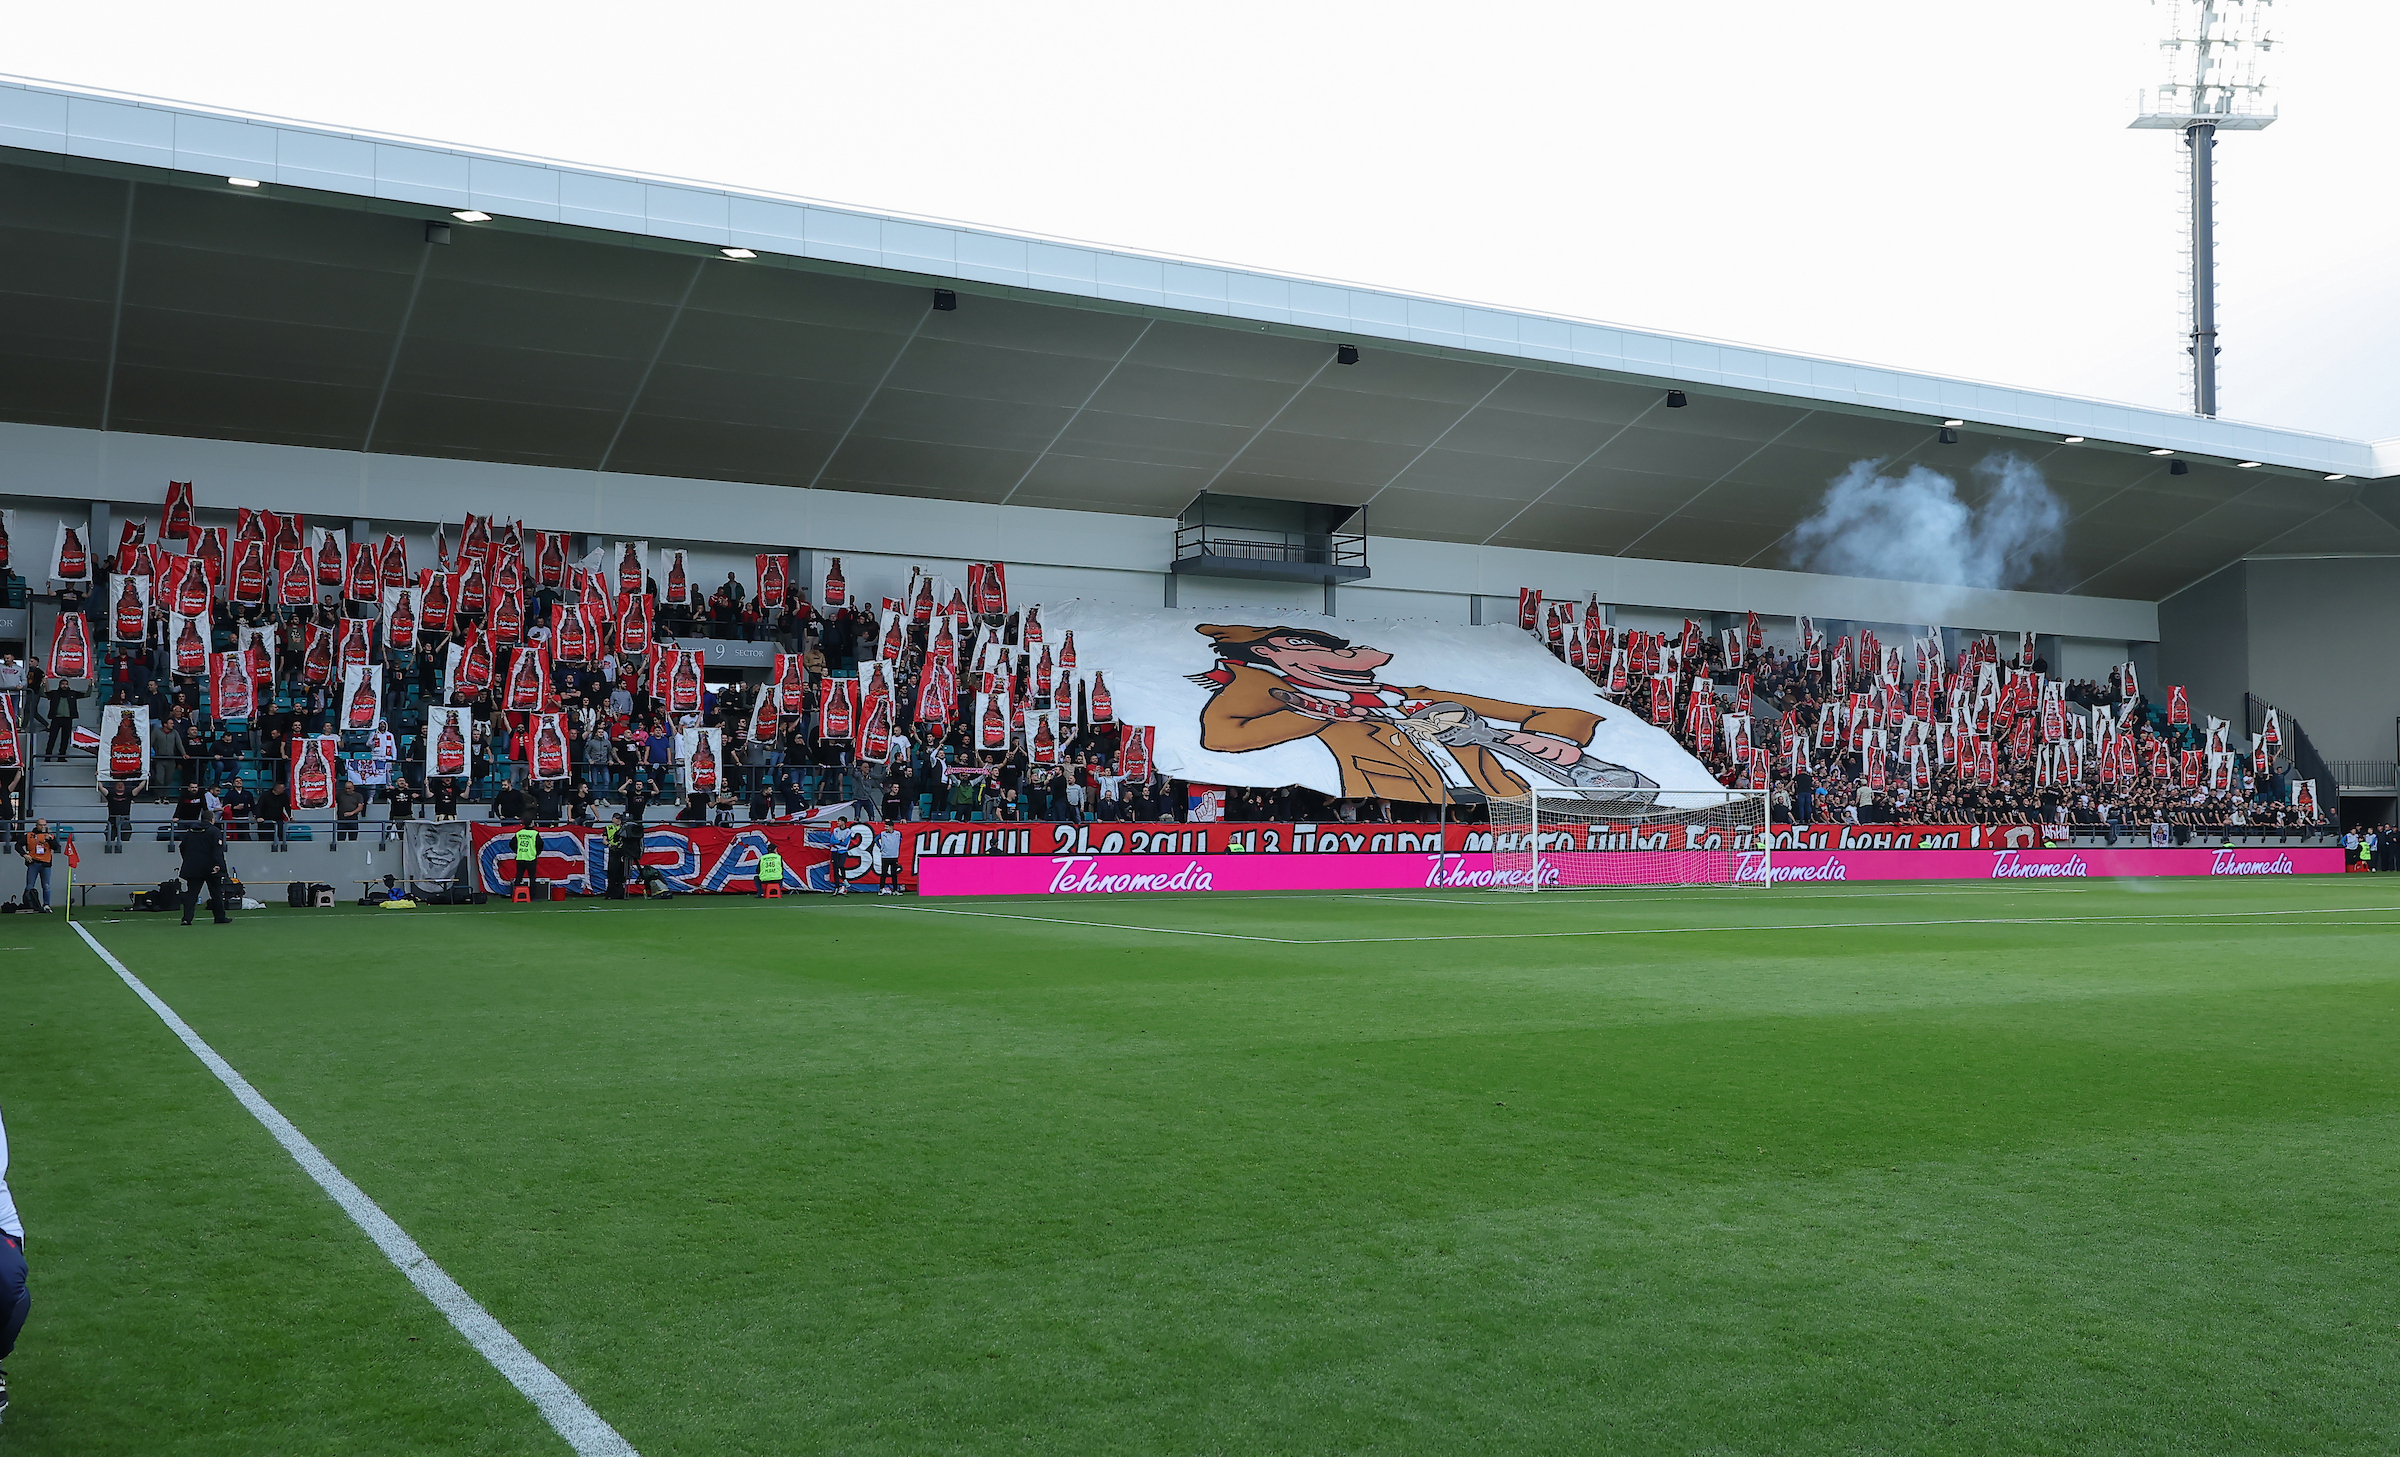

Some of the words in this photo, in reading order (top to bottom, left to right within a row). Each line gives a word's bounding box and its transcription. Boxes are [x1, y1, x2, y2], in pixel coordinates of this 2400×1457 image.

[715, 643, 726, 660] 9
[734, 649, 764, 658] SECTOR
[1048, 855, 1214, 894] Tehnomedia
[1425, 853, 1560, 887] Tehnomedia
[1734, 851, 1847, 882] Tehnomedia
[1992, 850, 2087, 878] Tehnomedia
[2210, 848, 2294, 876] Tehnomedia
